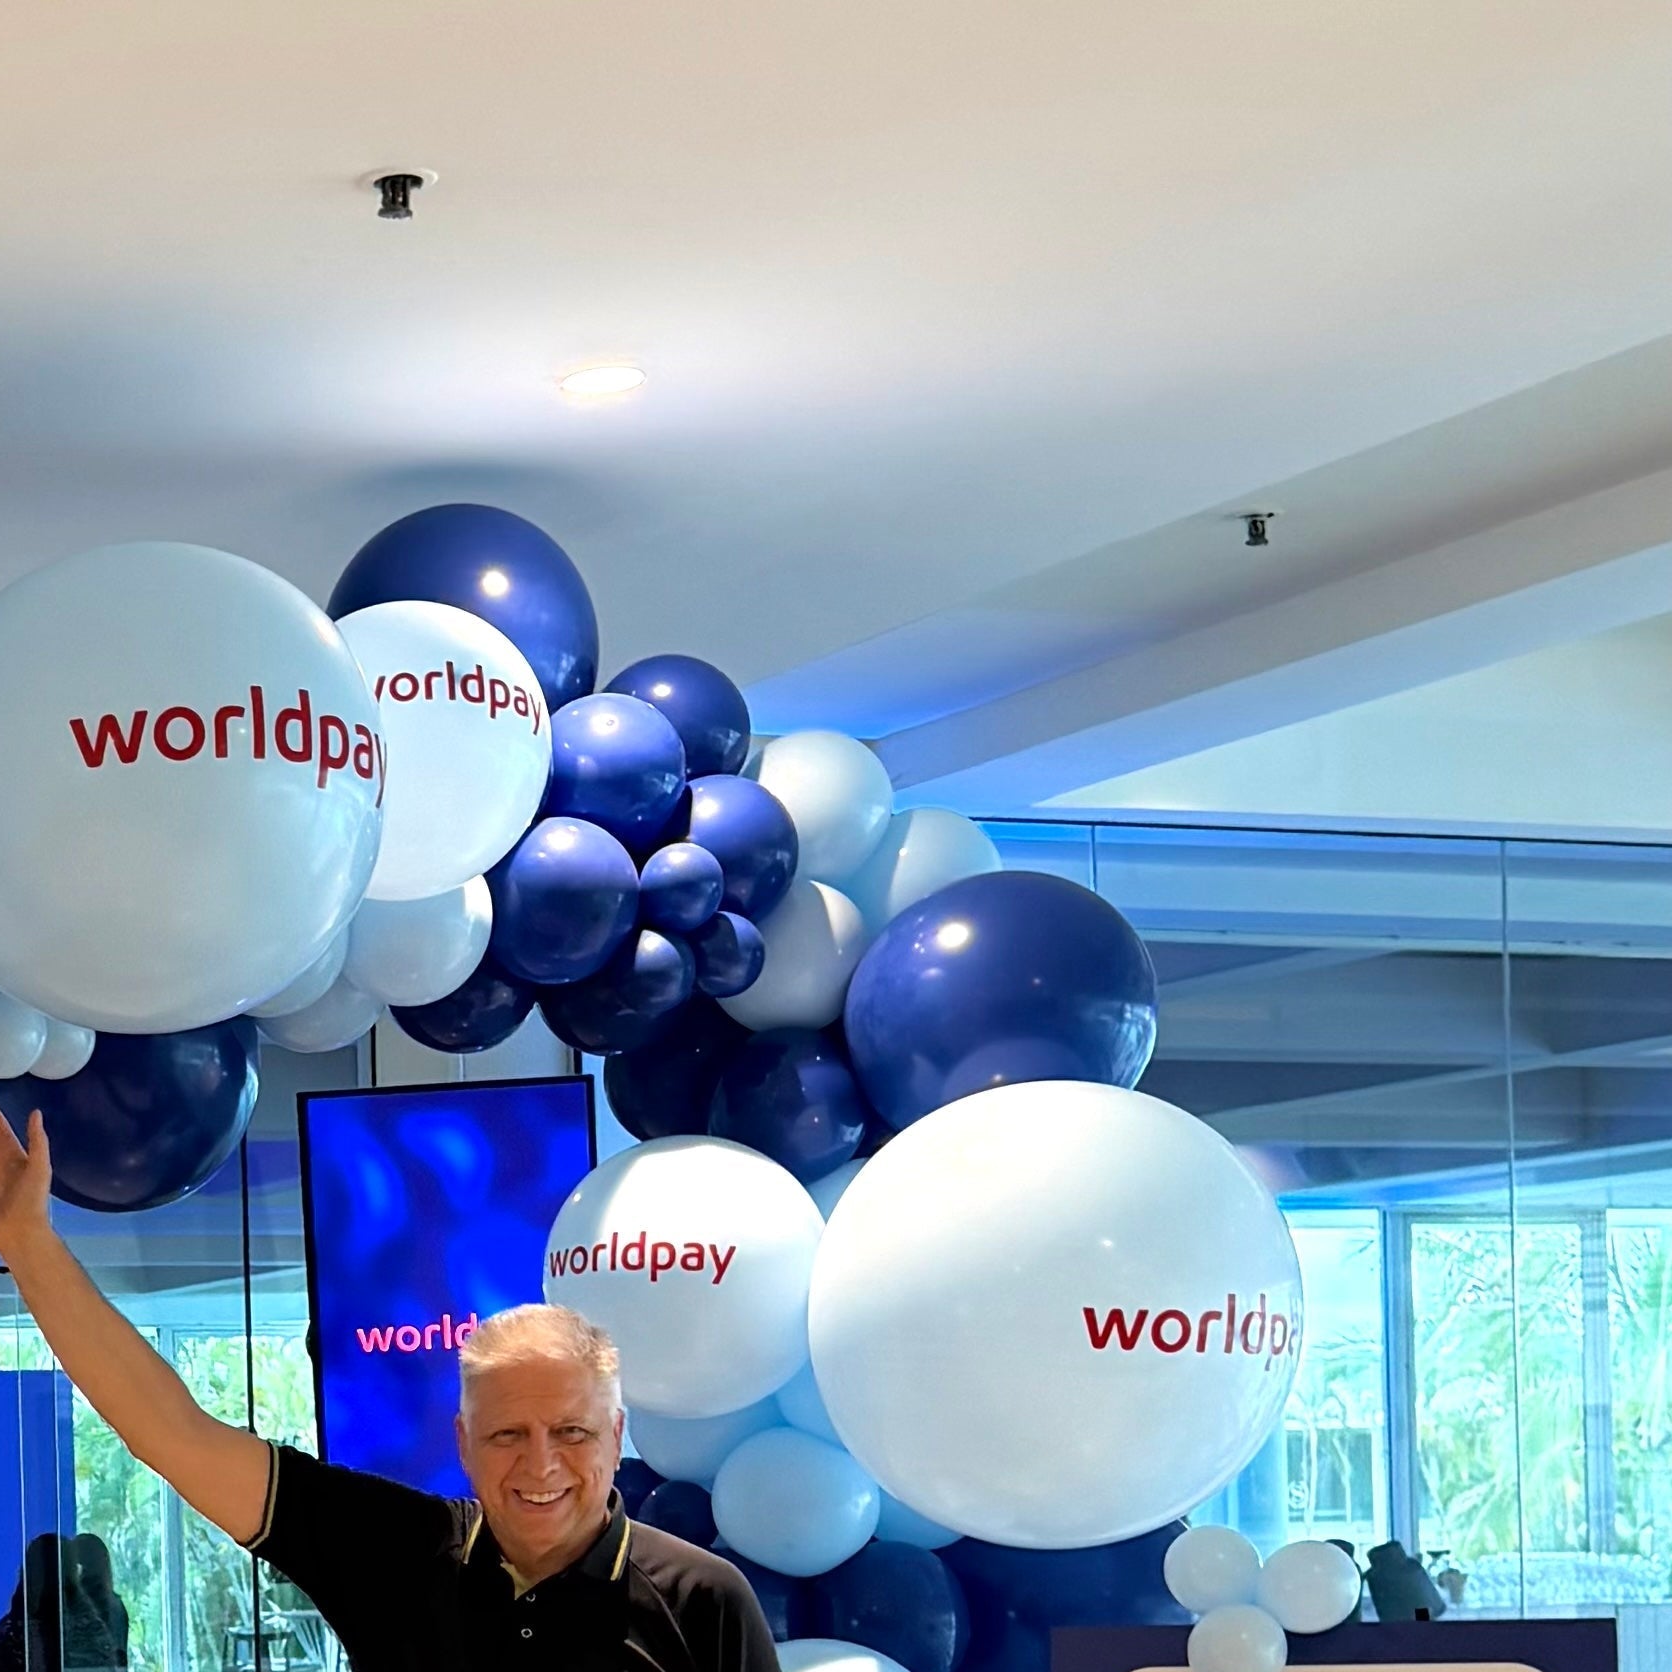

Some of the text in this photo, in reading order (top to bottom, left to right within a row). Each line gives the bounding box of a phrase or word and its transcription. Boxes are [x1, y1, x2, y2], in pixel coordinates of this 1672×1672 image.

[69, 685, 386, 808] worldpay
[549, 1231, 736, 1285] worldpay
[356, 1313, 480, 1352] world
[1082, 1293, 1297, 1372] worldp
